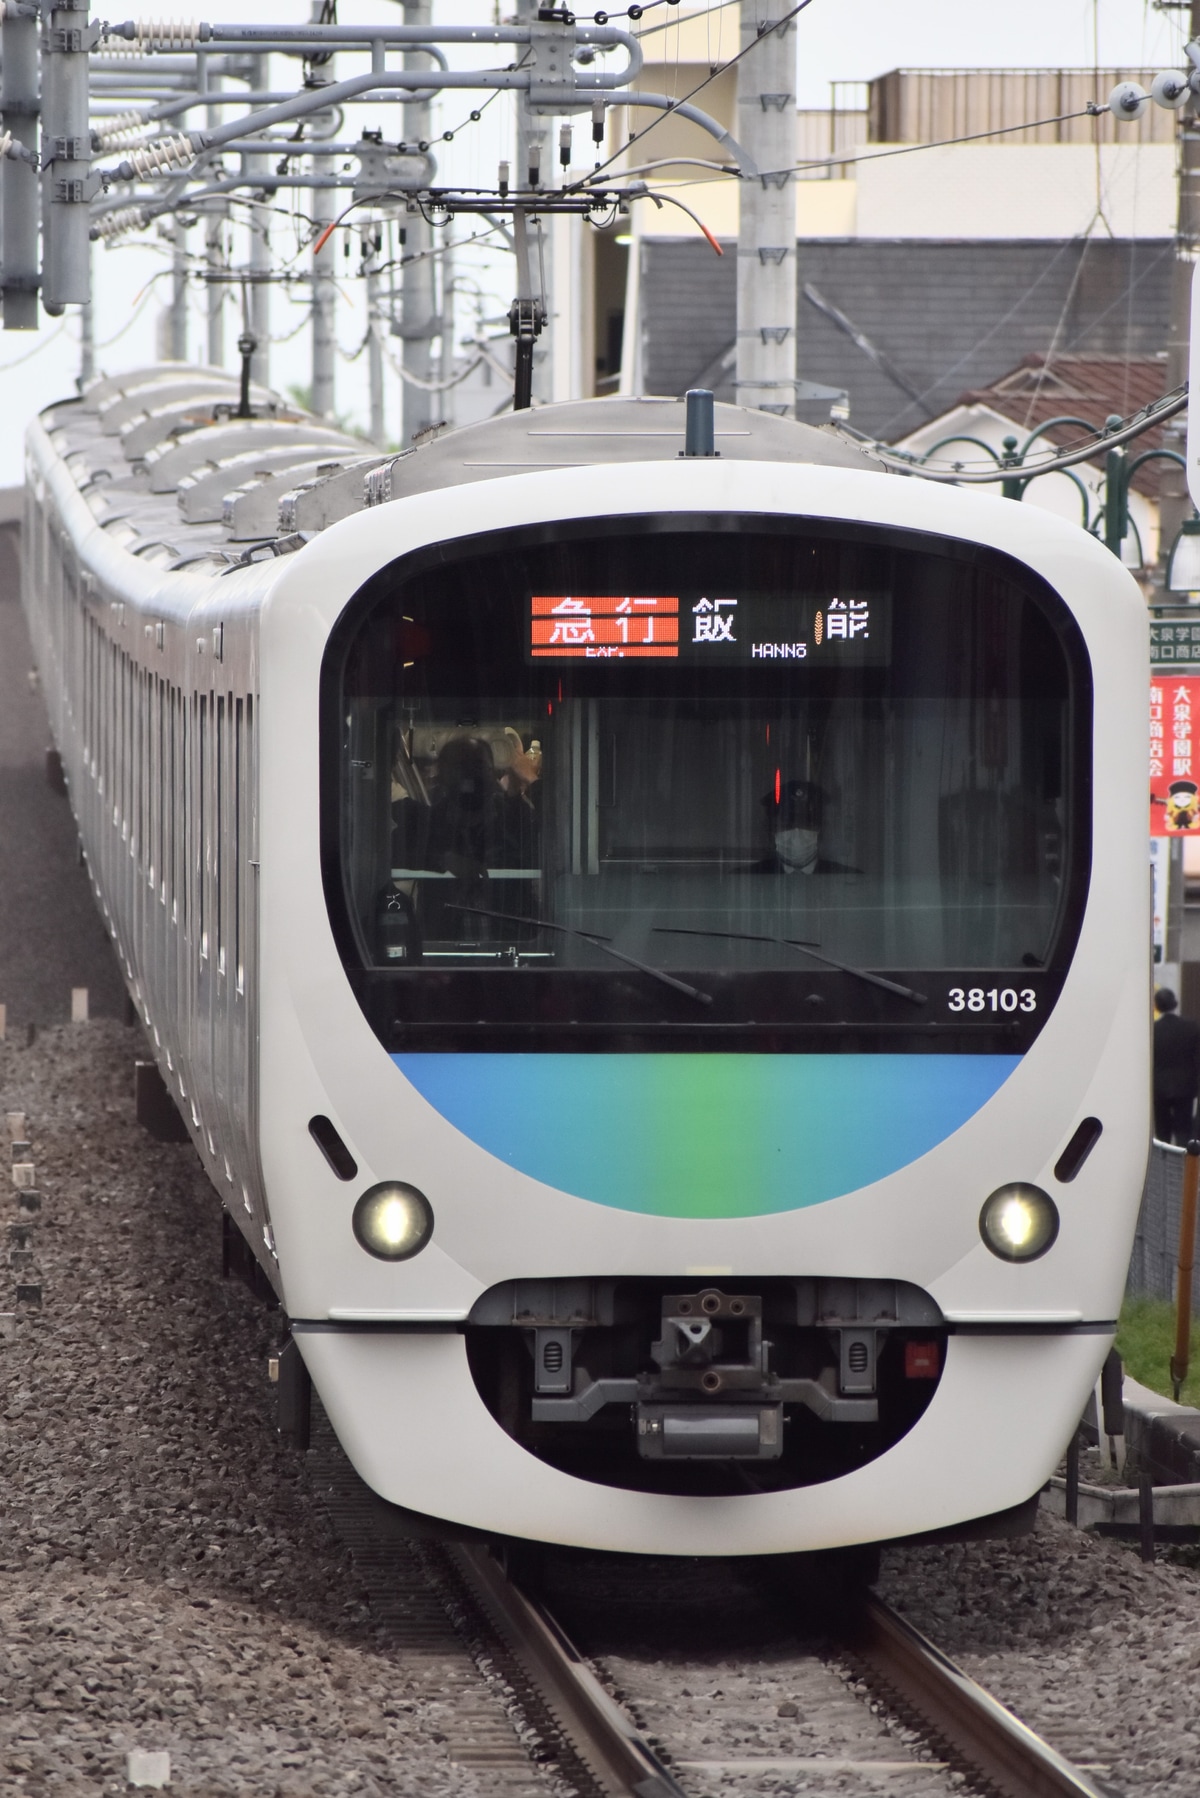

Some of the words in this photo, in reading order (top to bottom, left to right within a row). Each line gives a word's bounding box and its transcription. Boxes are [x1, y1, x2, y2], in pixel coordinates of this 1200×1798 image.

[549, 597, 658, 643] 急行
[1172, 685, 1192, 776] 大泉学園駅
[948, 988, 1037, 1012] 38103
